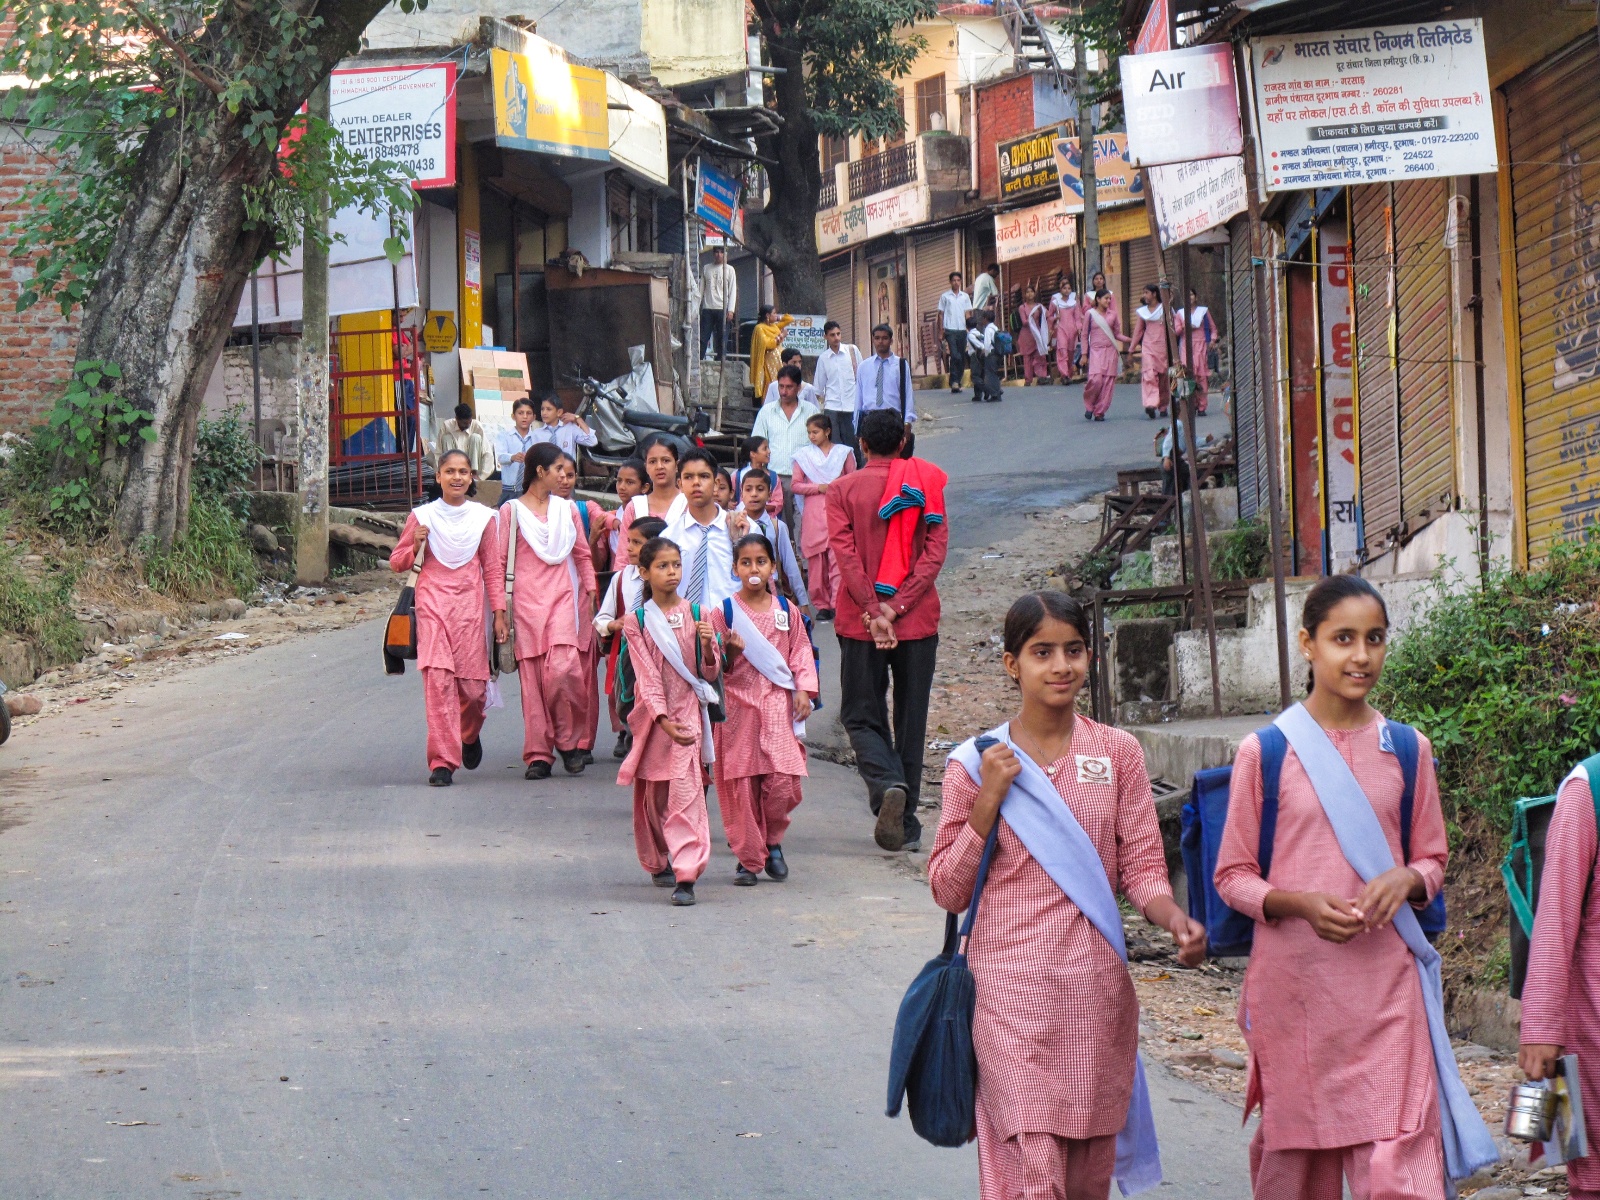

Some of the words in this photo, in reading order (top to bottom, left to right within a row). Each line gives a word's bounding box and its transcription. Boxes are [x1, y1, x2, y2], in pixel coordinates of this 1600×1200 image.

[1294, 41, 1330, 57] भारत
[1333, 34, 1371, 55] संचार
[1374, 30, 1415, 51] निगम
[1417, 23, 1472, 48] लिमिटेड
[1336, 62, 1345, 72] दूर
[1346, 59, 1363, 69] संचार
[1365, 57, 1381, 67] जिला
[1383, 56, 1407, 67] हमीरपुर
[399, 82, 436, 90] GOVERNMENT
[1315, 79, 1330, 87] नाम
[1373, 86, 1403, 96] 260281
[1285, 111, 1297, 121] पर
[1376, 100, 1396, 113] कॉल
[1398, 97, 1410, 111] की
[1413, 96, 1440, 113] सुविधा
[1442, 96, 1472, 107] उपलब्ध
[340, 116, 369, 126] AUTH.
[372, 113, 411, 123] DEALER
[348, 123, 442, 145] ENTERPRISES
[1317, 127, 1349, 137] शिकायत
[1351, 125, 1358, 134] के
[1422, 132, 1479, 144] 01972-223200
[1403, 150, 1433, 160] 224522
[1404, 163, 1434, 172] 266400
[997, 218, 1021, 241] बन्टी
[1028, 214, 1040, 236] दी
